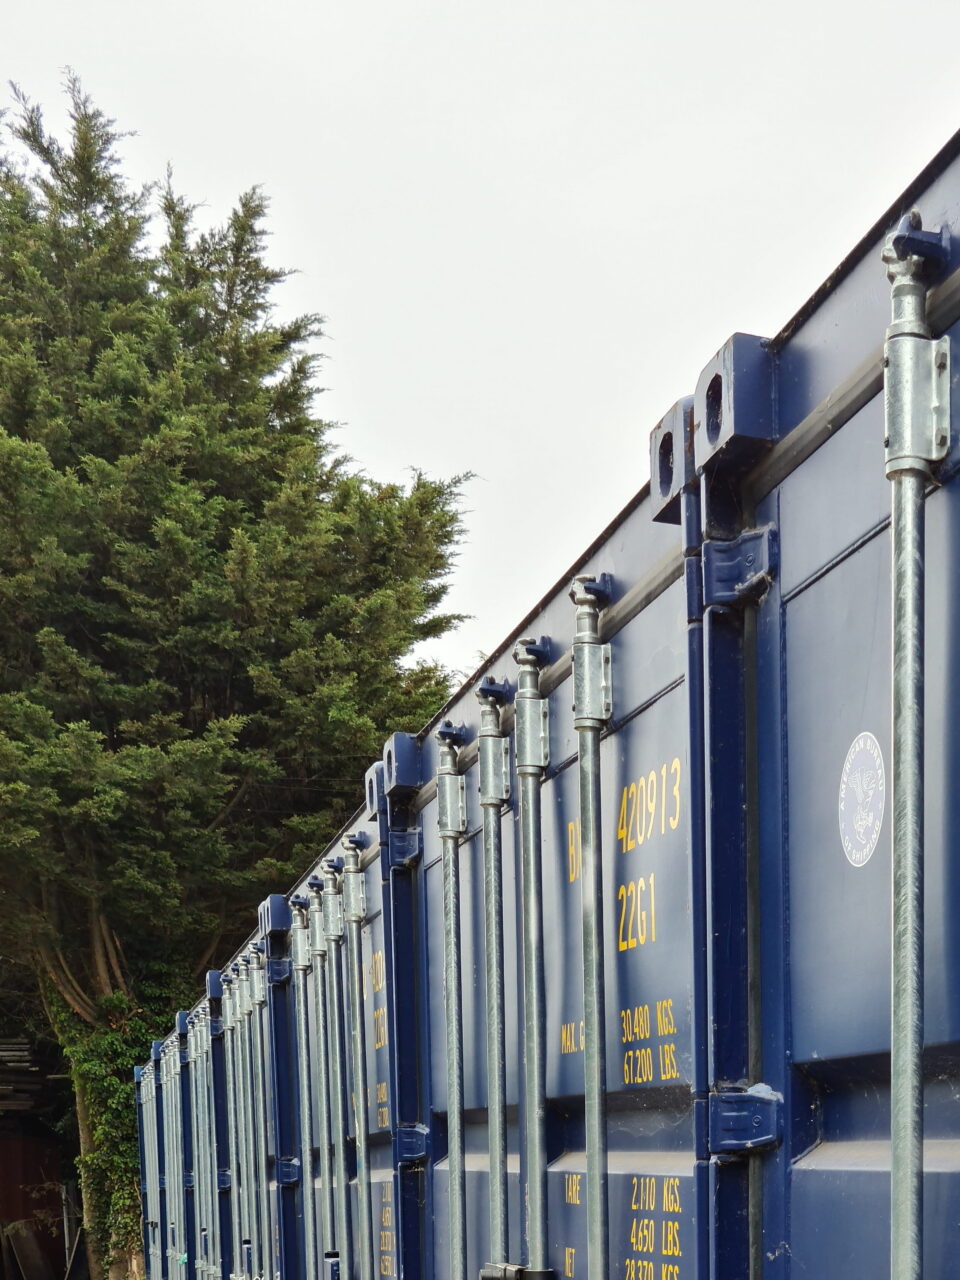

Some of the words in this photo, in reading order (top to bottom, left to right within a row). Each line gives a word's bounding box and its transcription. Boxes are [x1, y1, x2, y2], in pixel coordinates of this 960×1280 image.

[840, 739, 865, 811] AMERICAN
[866, 738, 884, 791] BUREAU
[617, 756, 682, 854] 420913
[851, 819, 881, 863] SHIPPING
[618, 872, 656, 952] 22G1
[656, 998, 677, 1037] KGS.
[658, 1042, 680, 1081] LBS.
[565, 1173, 582, 1205] TARE
[662, 1176, 683, 1214] KGS.
[661, 1220, 683, 1257] LBS.
